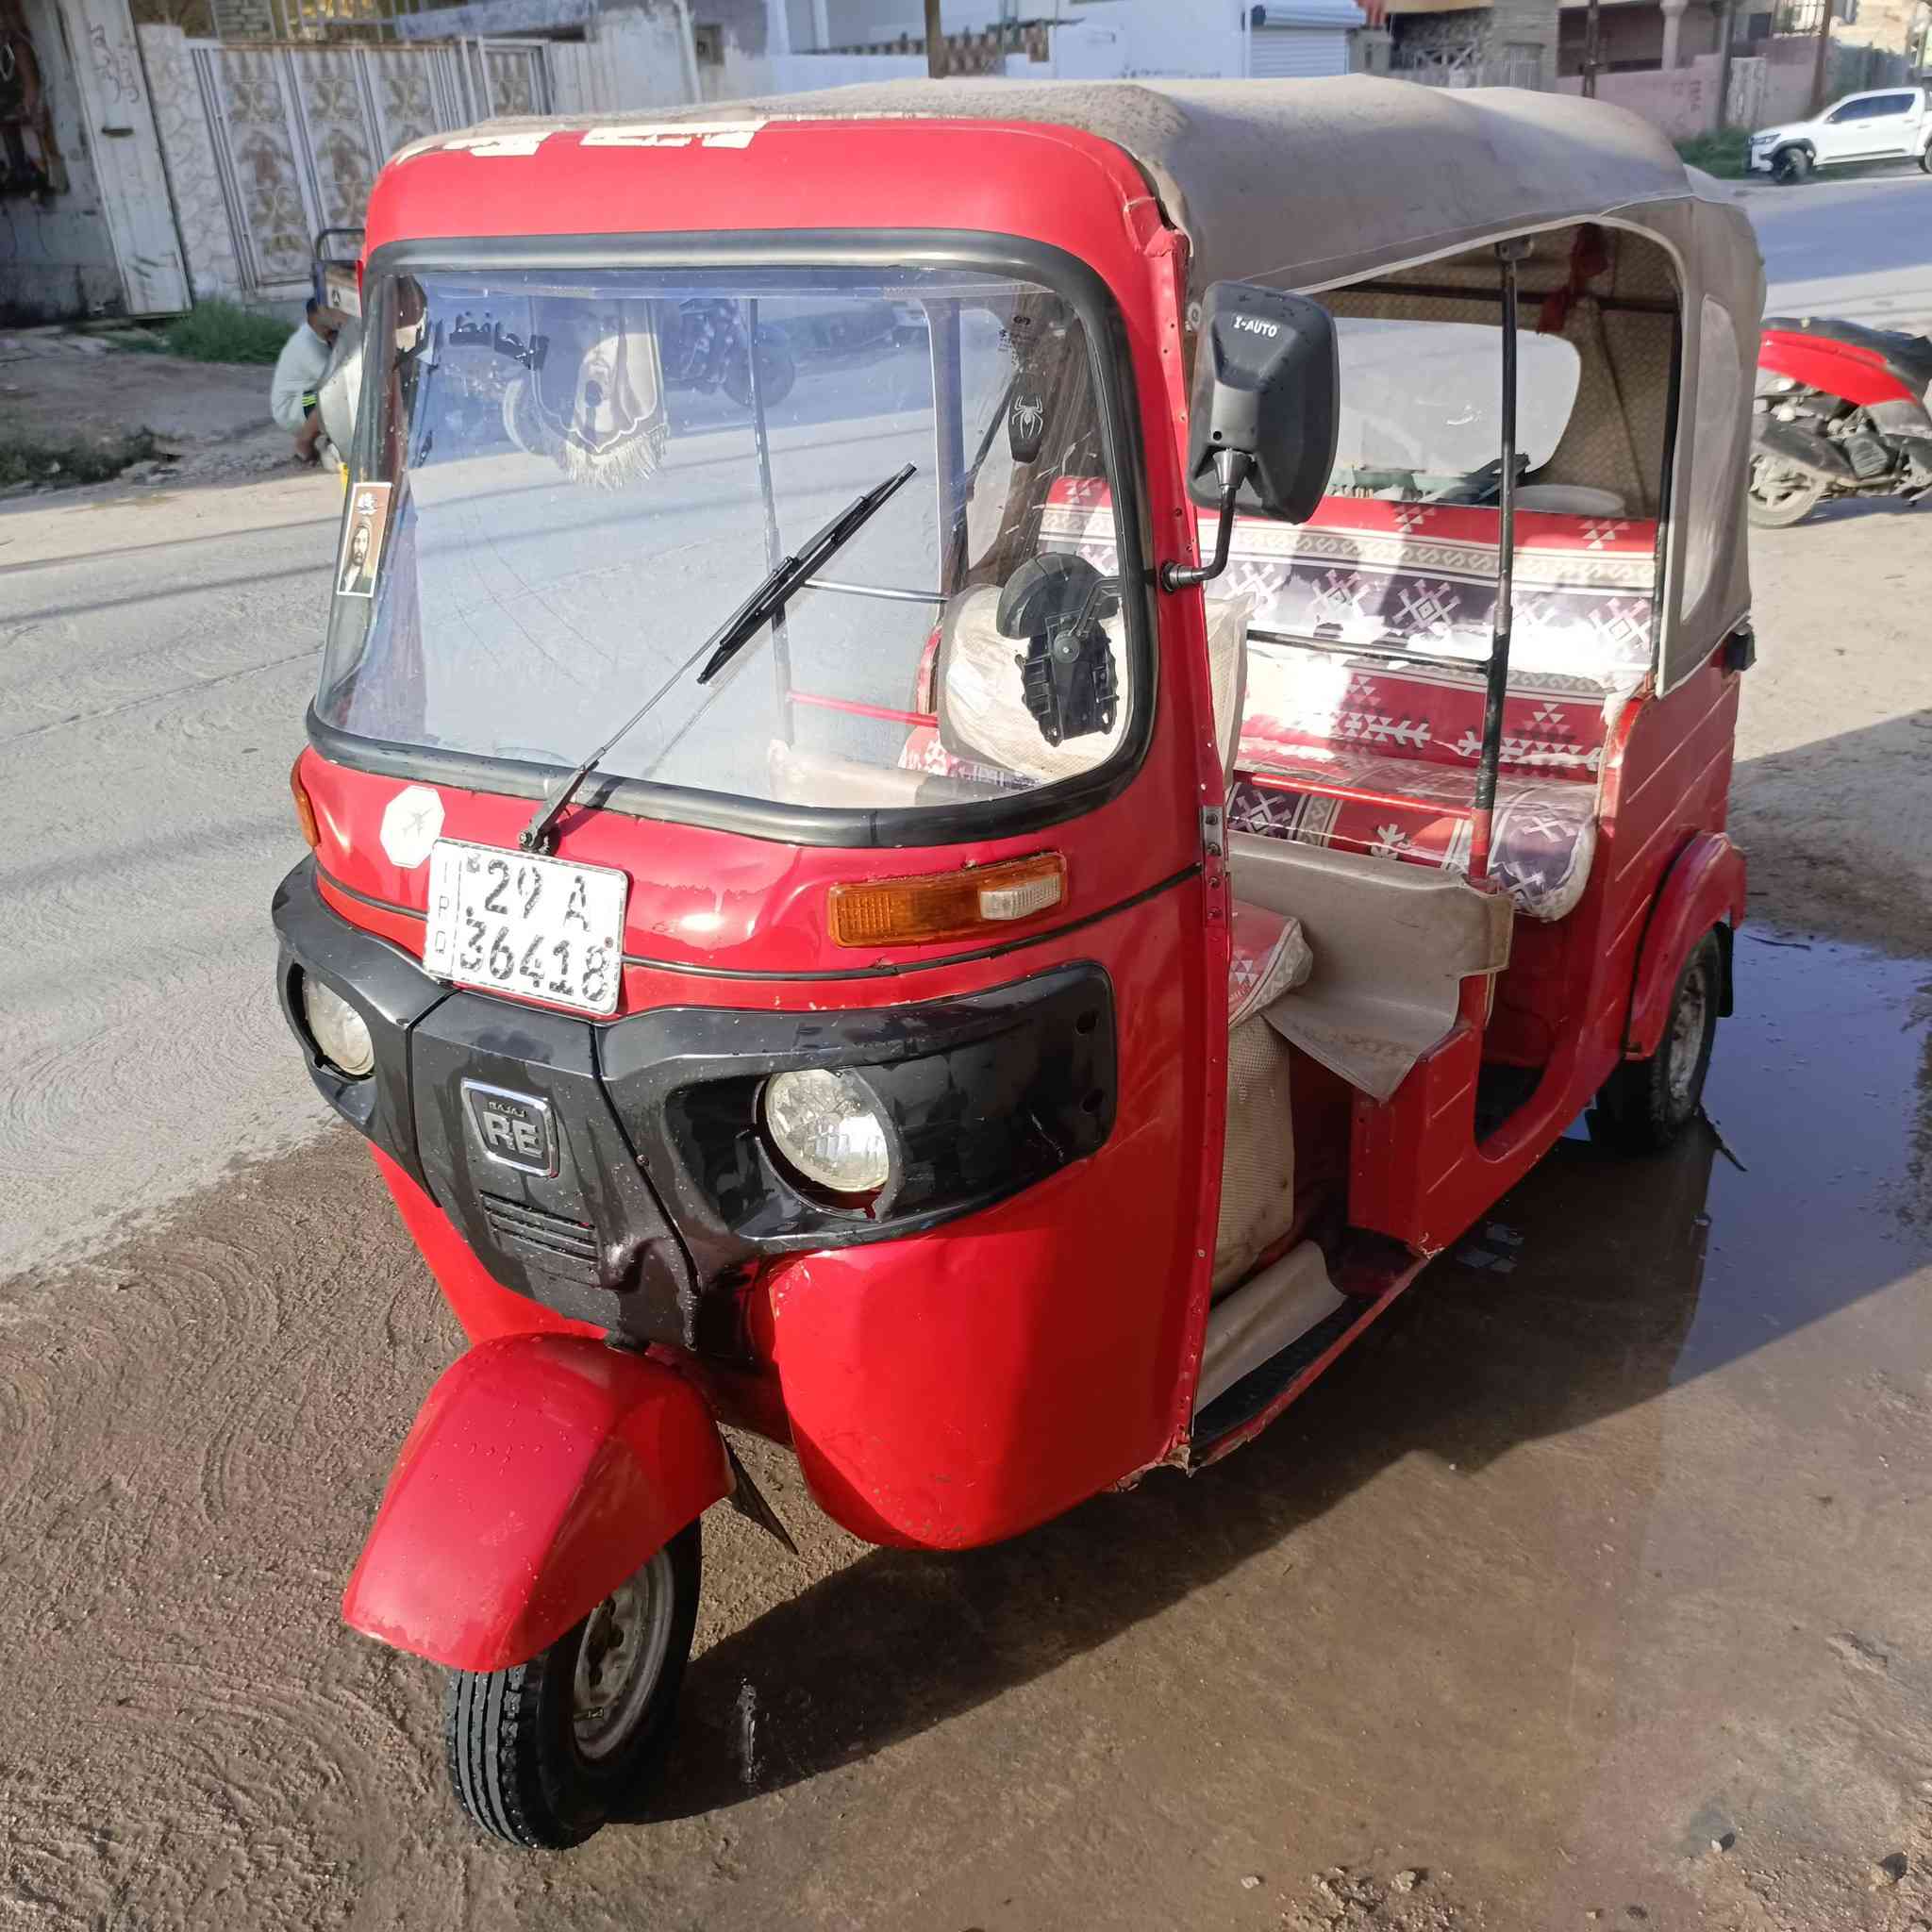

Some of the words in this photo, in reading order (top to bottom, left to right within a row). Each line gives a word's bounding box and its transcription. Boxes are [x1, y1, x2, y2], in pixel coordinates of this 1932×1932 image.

[563, 874, 591, 932] A
[459, 916, 610, 1002] 36418
[482, 1111, 544, 1159] RE
